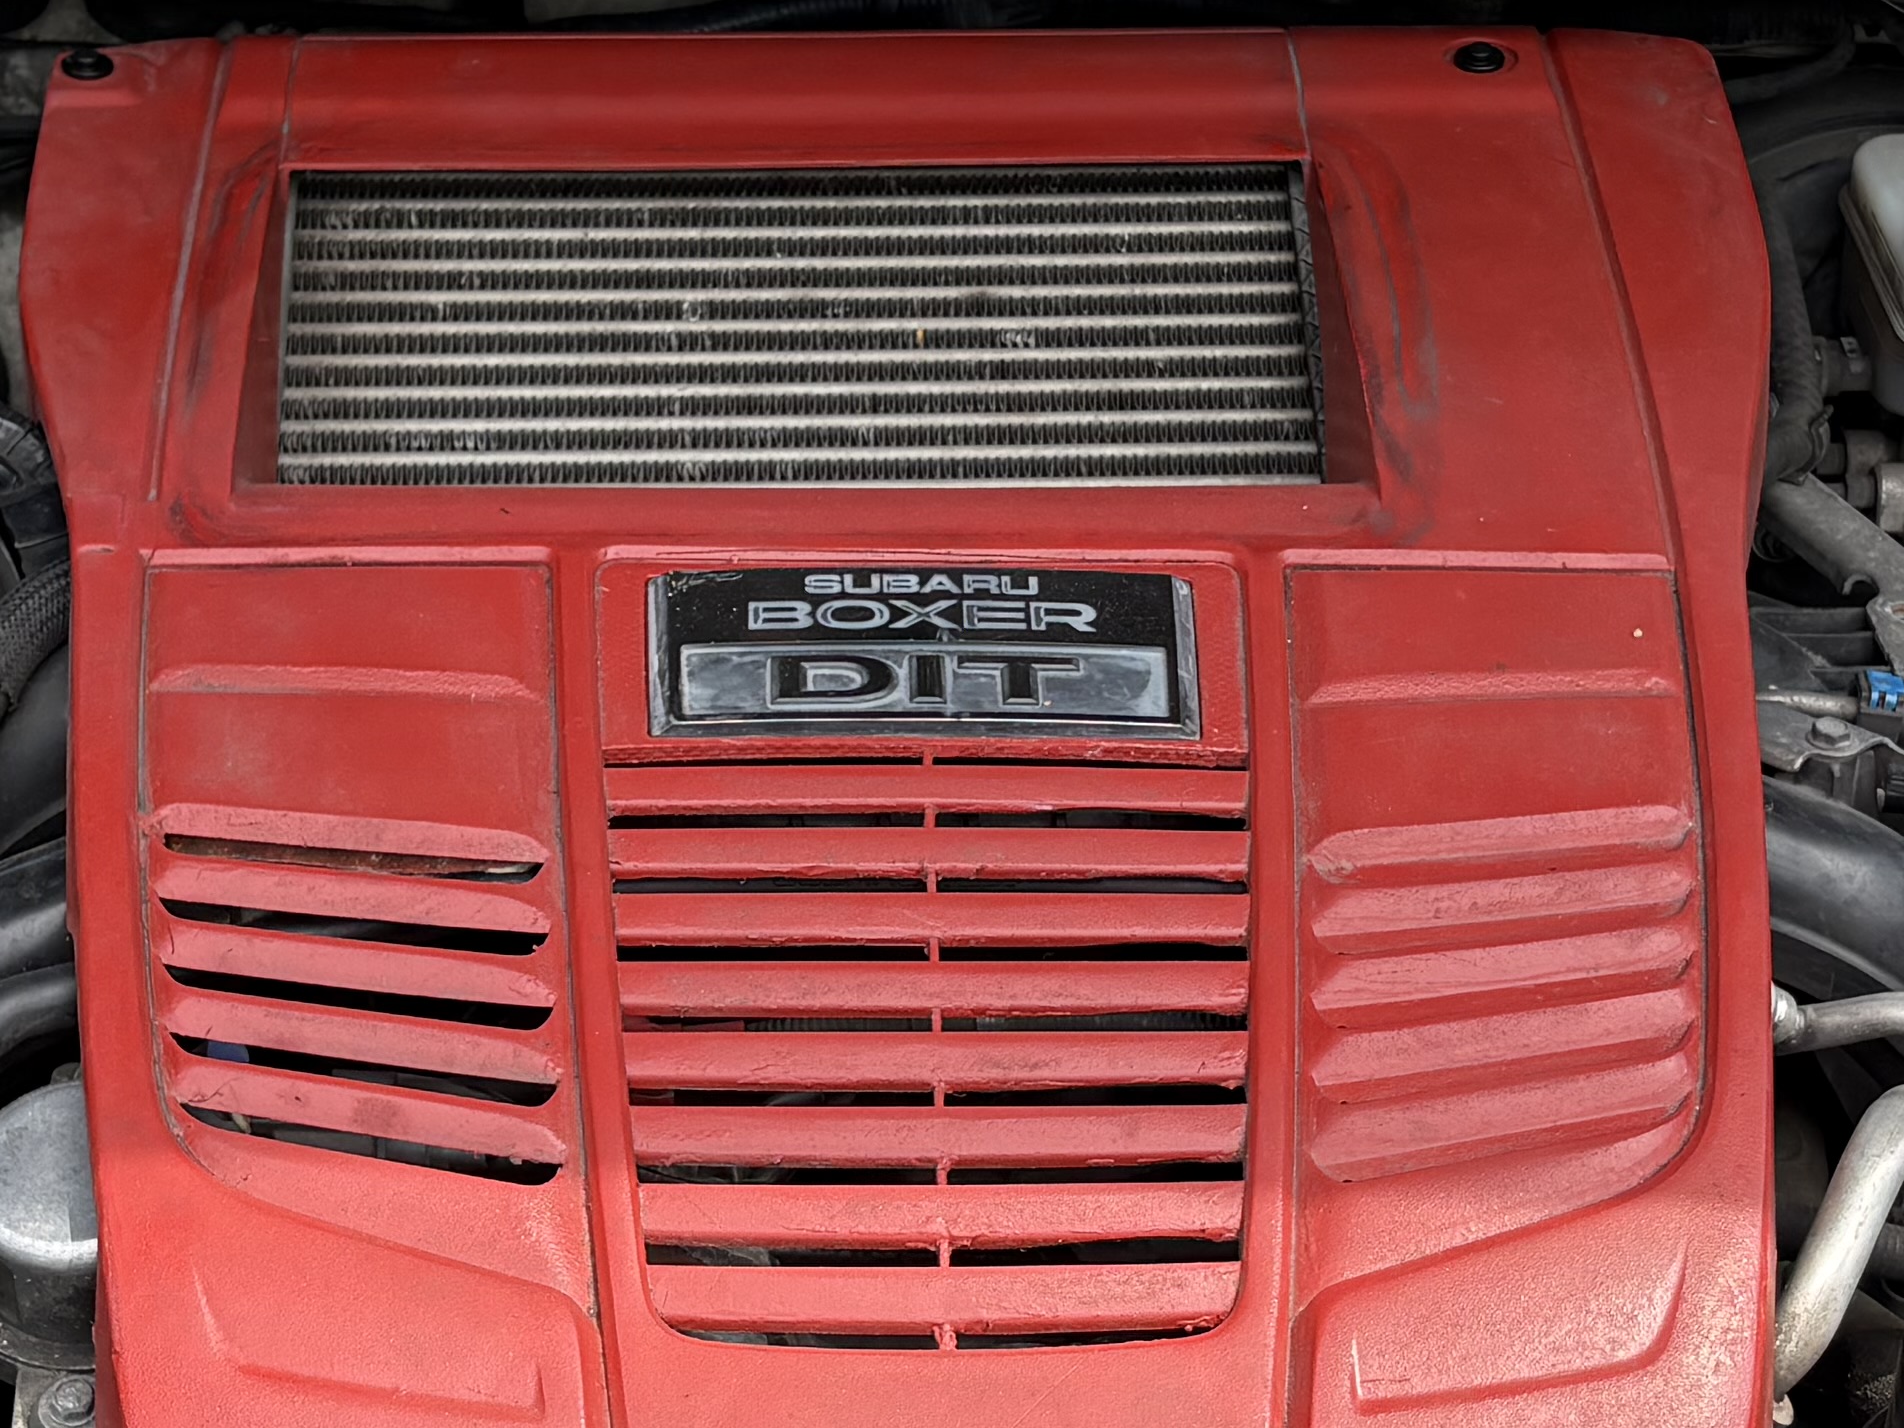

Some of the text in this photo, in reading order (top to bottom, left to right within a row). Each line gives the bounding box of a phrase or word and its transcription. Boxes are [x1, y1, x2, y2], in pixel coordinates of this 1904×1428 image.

[803, 572, 1040, 596] SUBARU
[746, 599, 1098, 633] BOXER
[767, 654, 1084, 710] DIT
